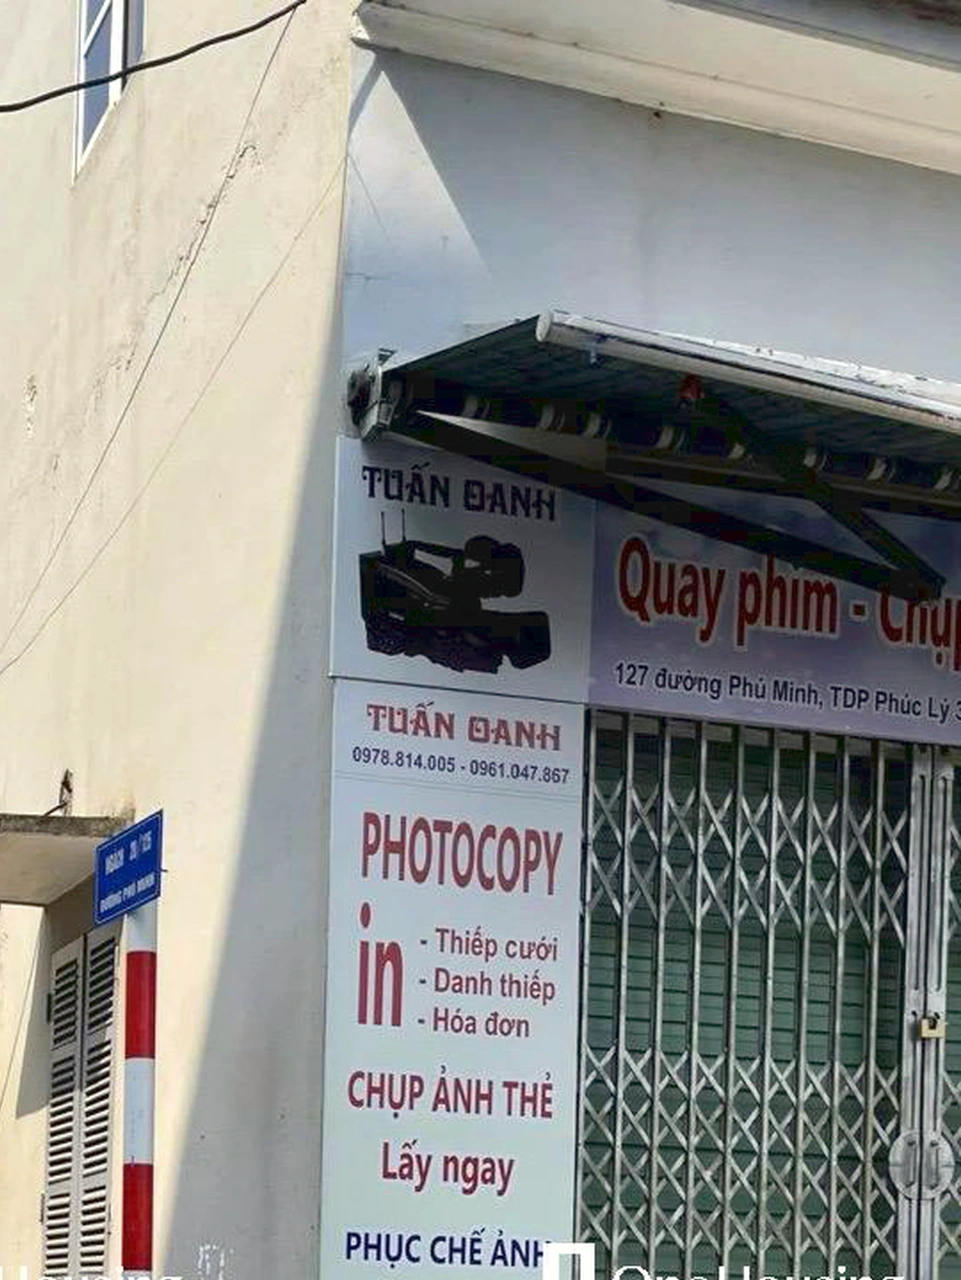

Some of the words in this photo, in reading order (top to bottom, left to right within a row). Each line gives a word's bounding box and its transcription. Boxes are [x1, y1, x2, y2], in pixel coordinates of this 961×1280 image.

[362, 462, 450, 508] TUẤN
[463, 478, 556, 521] OANH
[619, 537, 726, 643] Quay
[736, 553, 837, 646] phim
[616, 662, 649, 686] 127
[655, 666, 722, 700] đường
[729, 675, 766, 698] Phú
[772, 679, 823, 710] Minh,
[830, 686, 869, 710] TDP
[875, 690, 922, 716] Phúc
[928, 697, 950, 724] Lý
[367, 701, 455, 739] TUẤN
[467, 715, 561, 751] OANH
[352, 746, 456, 773] 0978.814.005
[470, 759, 570, 784] 0961.047.867
[362, 812, 563, 896] PHOTOCOPY
[357, 902, 403, 1027] in
[436, 925, 498, 962] Thiếp
[505, 937, 558, 961] cưới
[434, 968, 492, 997] Danh
[500, 973, 556, 1006] thiếp
[433, 1008, 476, 1035] Hóa
[485, 1011, 530, 1038] đơn
[348, 1071, 425, 1119] CHỤP
[432, 1065, 493, 1116] ẢNH
[503, 1072, 554, 1119] THẺ
[382, 1138, 432, 1192] Lấy
[443, 1153, 515, 1196] ngay
[346, 1232, 421, 1269] PHỤC
[430, 1228, 486, 1266] CHẾ
